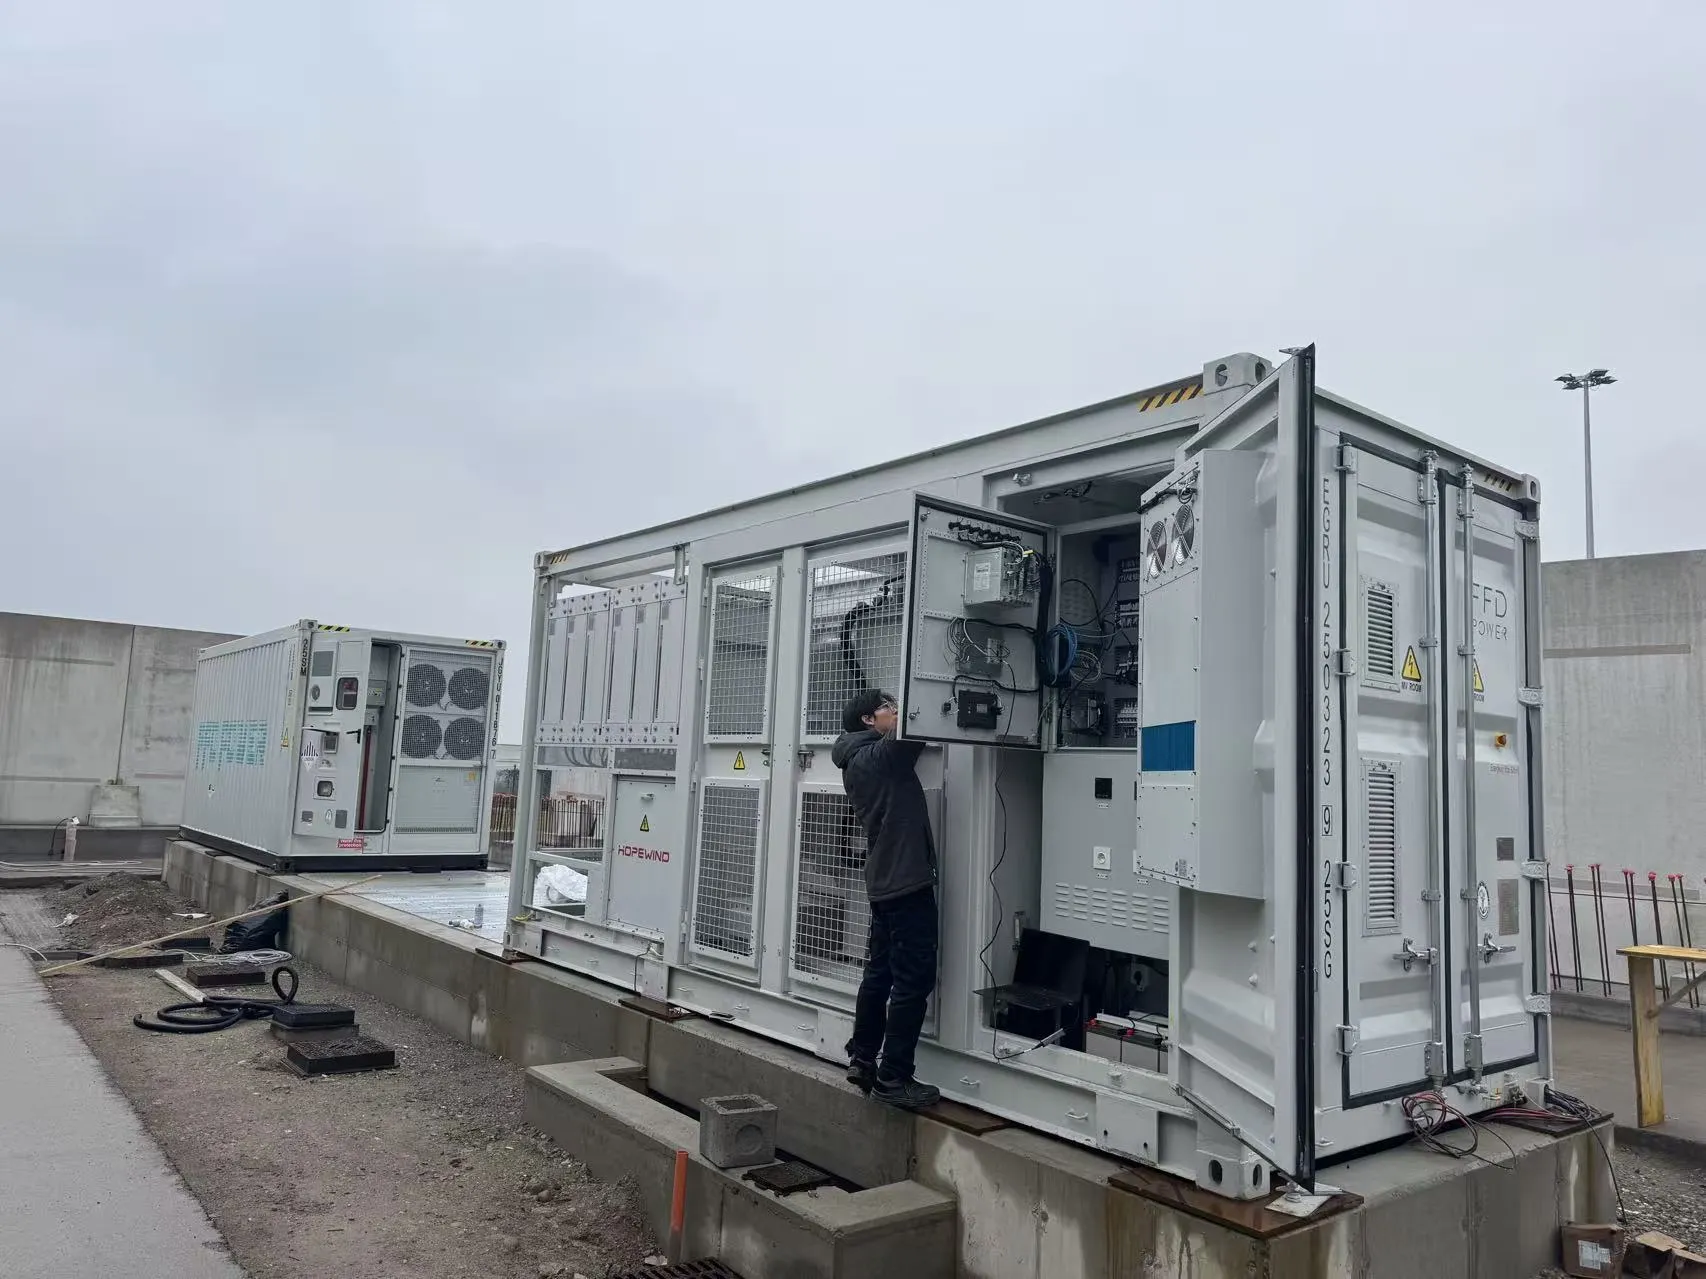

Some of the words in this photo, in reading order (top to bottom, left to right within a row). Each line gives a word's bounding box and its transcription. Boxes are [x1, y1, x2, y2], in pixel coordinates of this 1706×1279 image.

[1322, 478, 1331, 589] EGRU
[1323, 602, 1331, 785] 250323
[618, 845, 670, 863] HOPEWIND
[1323, 806, 1331, 834] 9
[1323, 860, 1332, 978] 25SG
